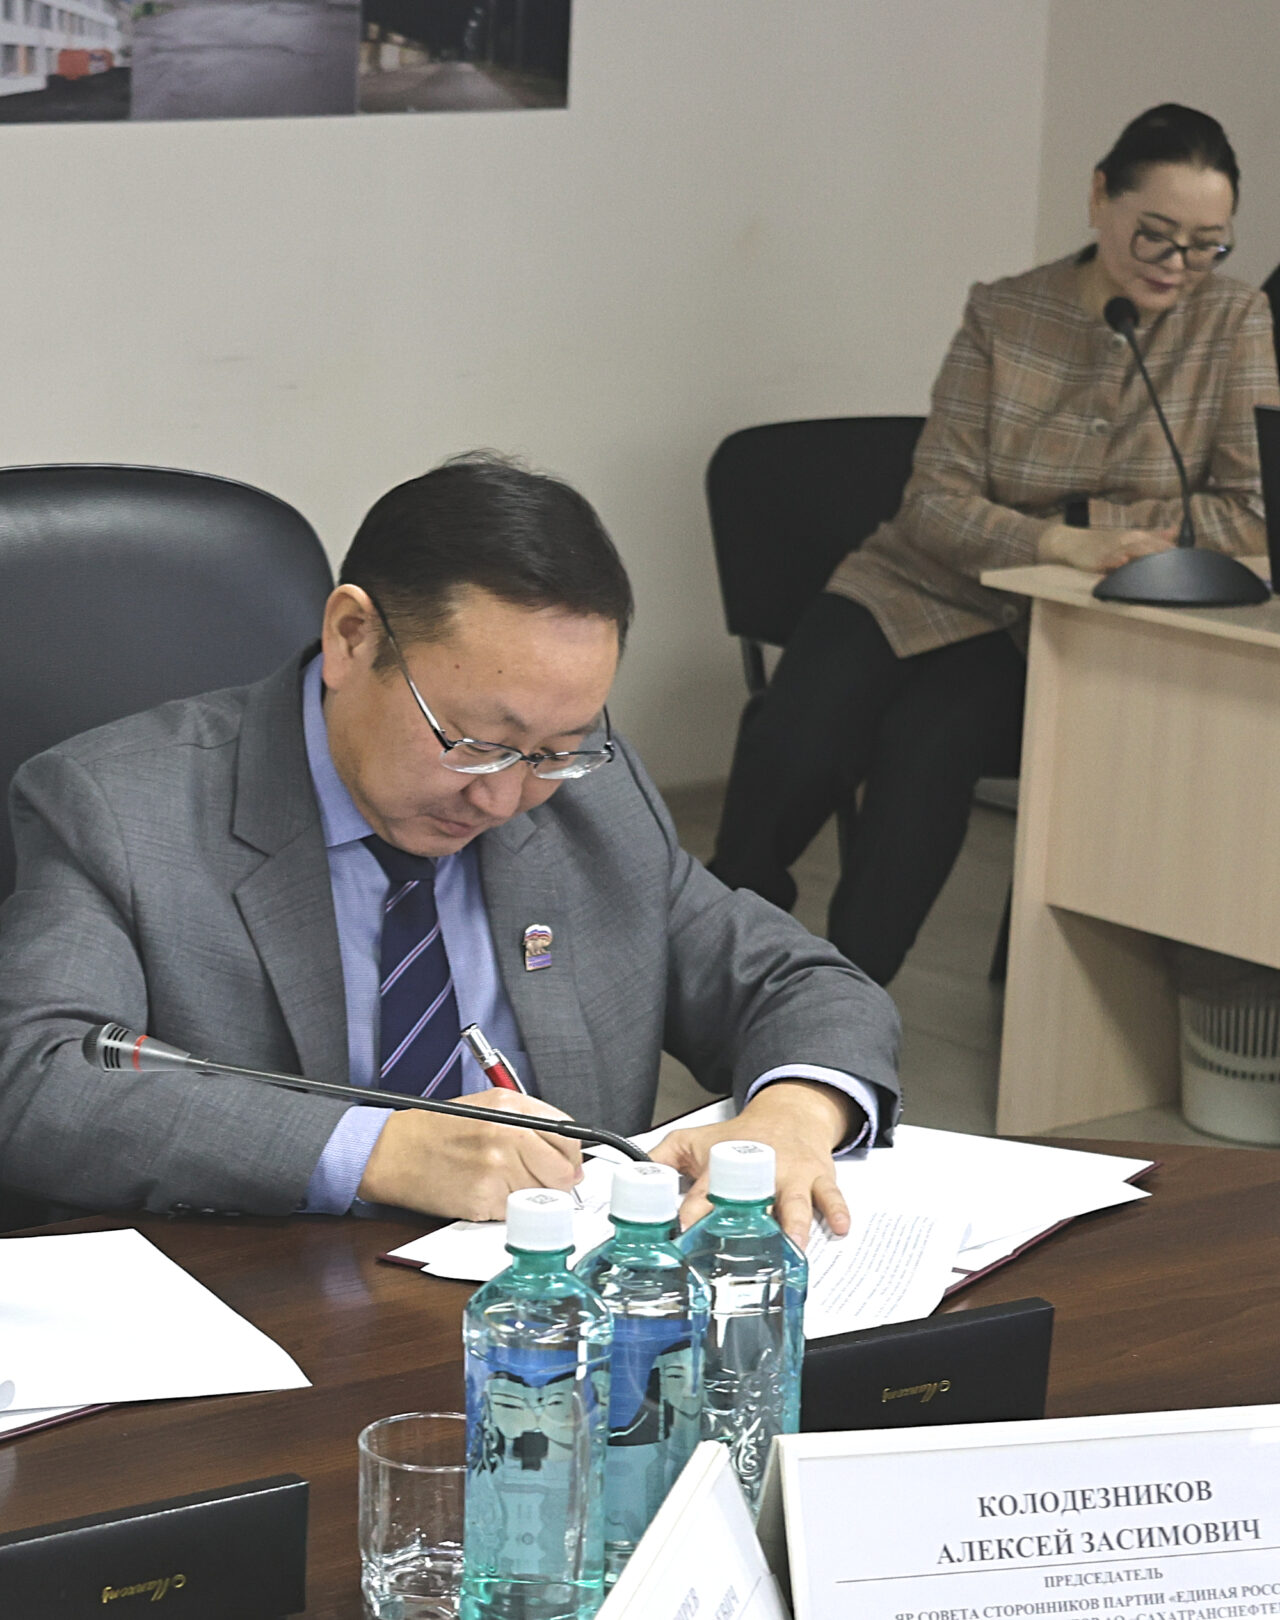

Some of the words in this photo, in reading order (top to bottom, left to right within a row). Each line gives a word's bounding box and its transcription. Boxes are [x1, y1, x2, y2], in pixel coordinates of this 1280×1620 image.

[977, 1480, 1213, 1518] КОЛОДЕЗНИКОВ
[936, 1528, 1074, 1565] АЛЕКСЕЙ
[1081, 1518, 1262, 1554] ЗАСИМОВИЧ
[1044, 1567, 1164, 1588] ПРЕДСЕДАТЕЛЬ
[918, 1608, 980, 1620] СОВЕТА
[983, 1598, 1100, 1619] СТОРОННИКОВ
[1103, 1592, 1165, 1609] ПАРТИИ
[1169, 1586, 1238, 1603] «ЕДИНАЯ
[1240, 1582, 1280, 1598] РОСС
